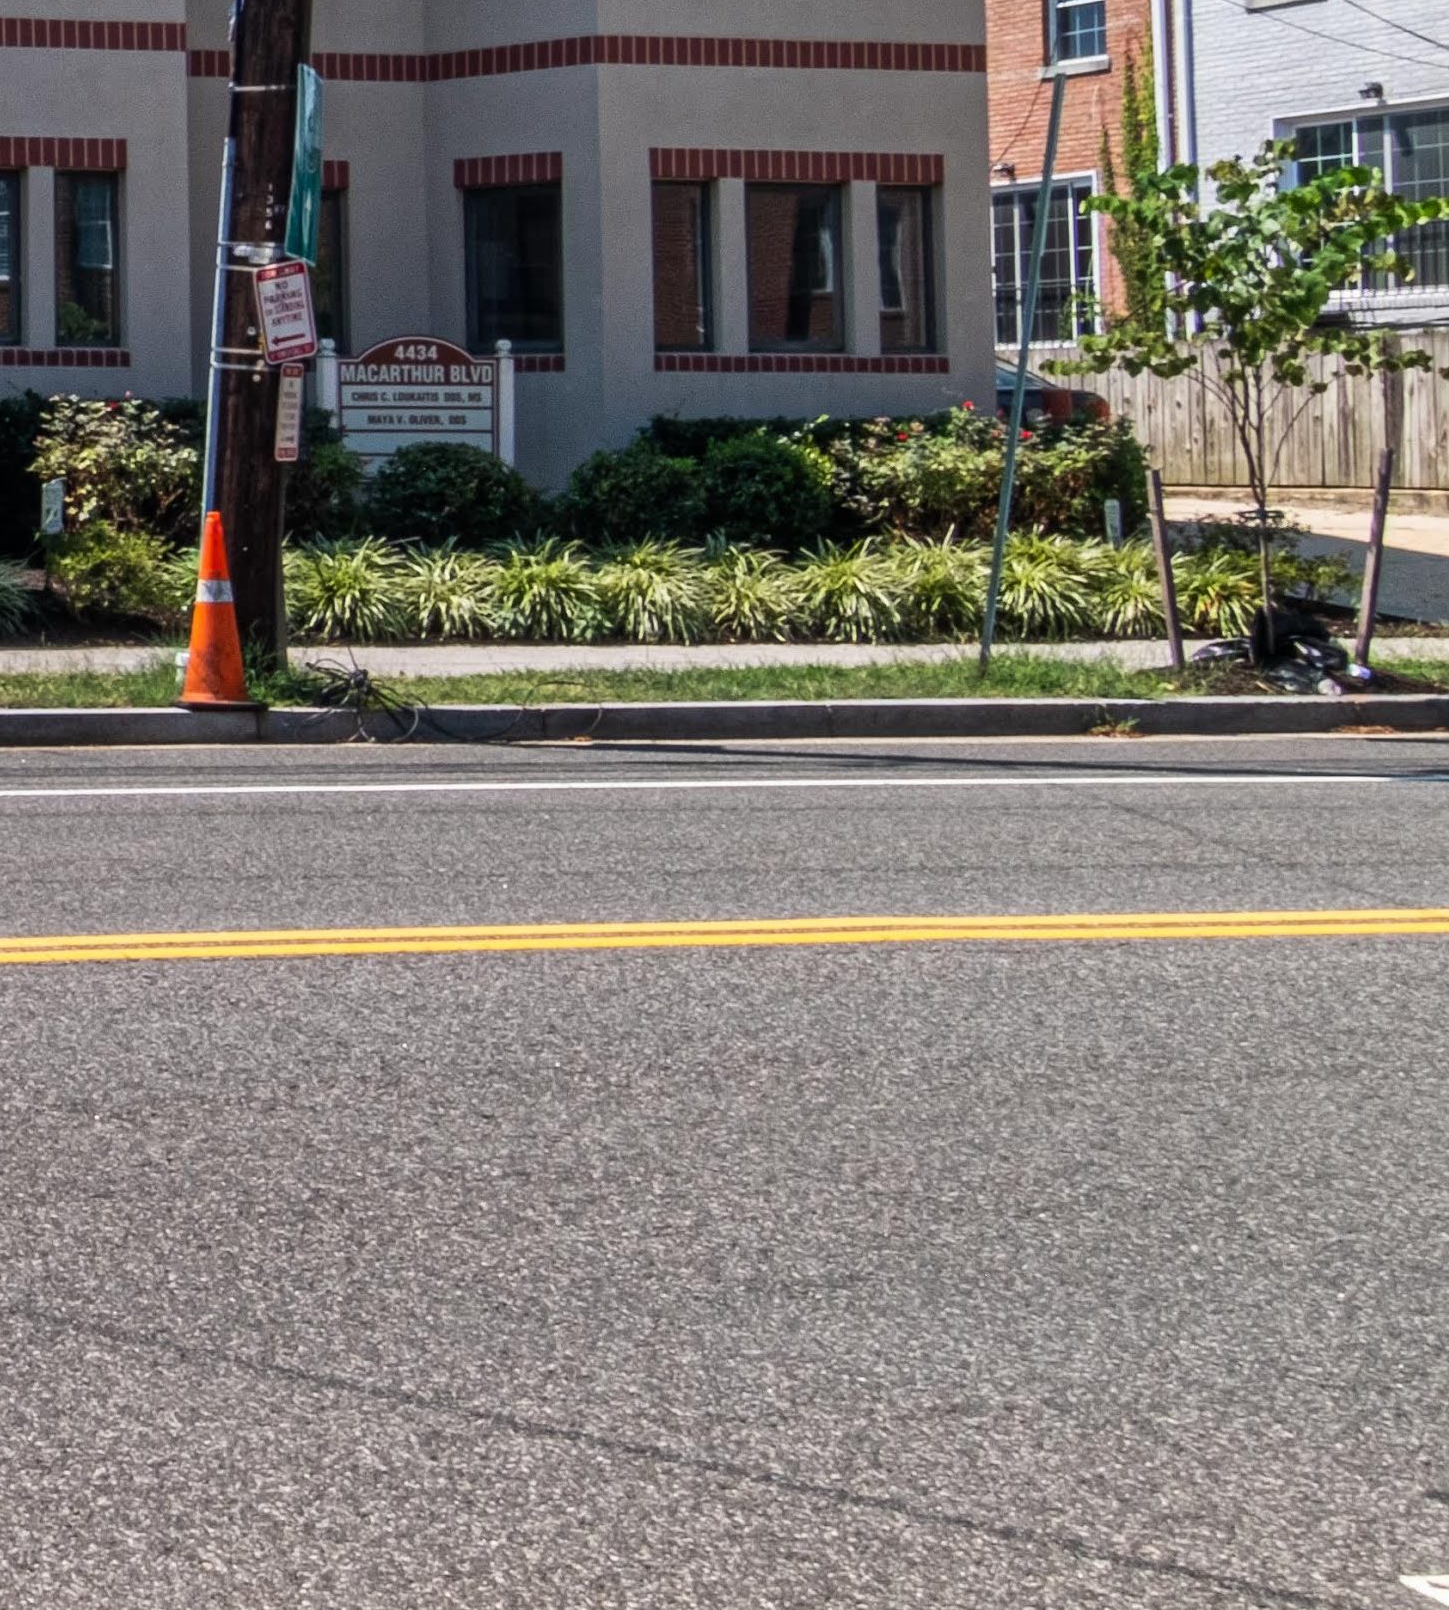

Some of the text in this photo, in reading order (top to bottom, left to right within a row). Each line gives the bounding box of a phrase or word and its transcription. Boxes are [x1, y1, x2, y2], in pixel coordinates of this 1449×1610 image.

[394, 344, 439, 361] 4434
[340, 364, 492, 383] MACARTHUR BLVD
